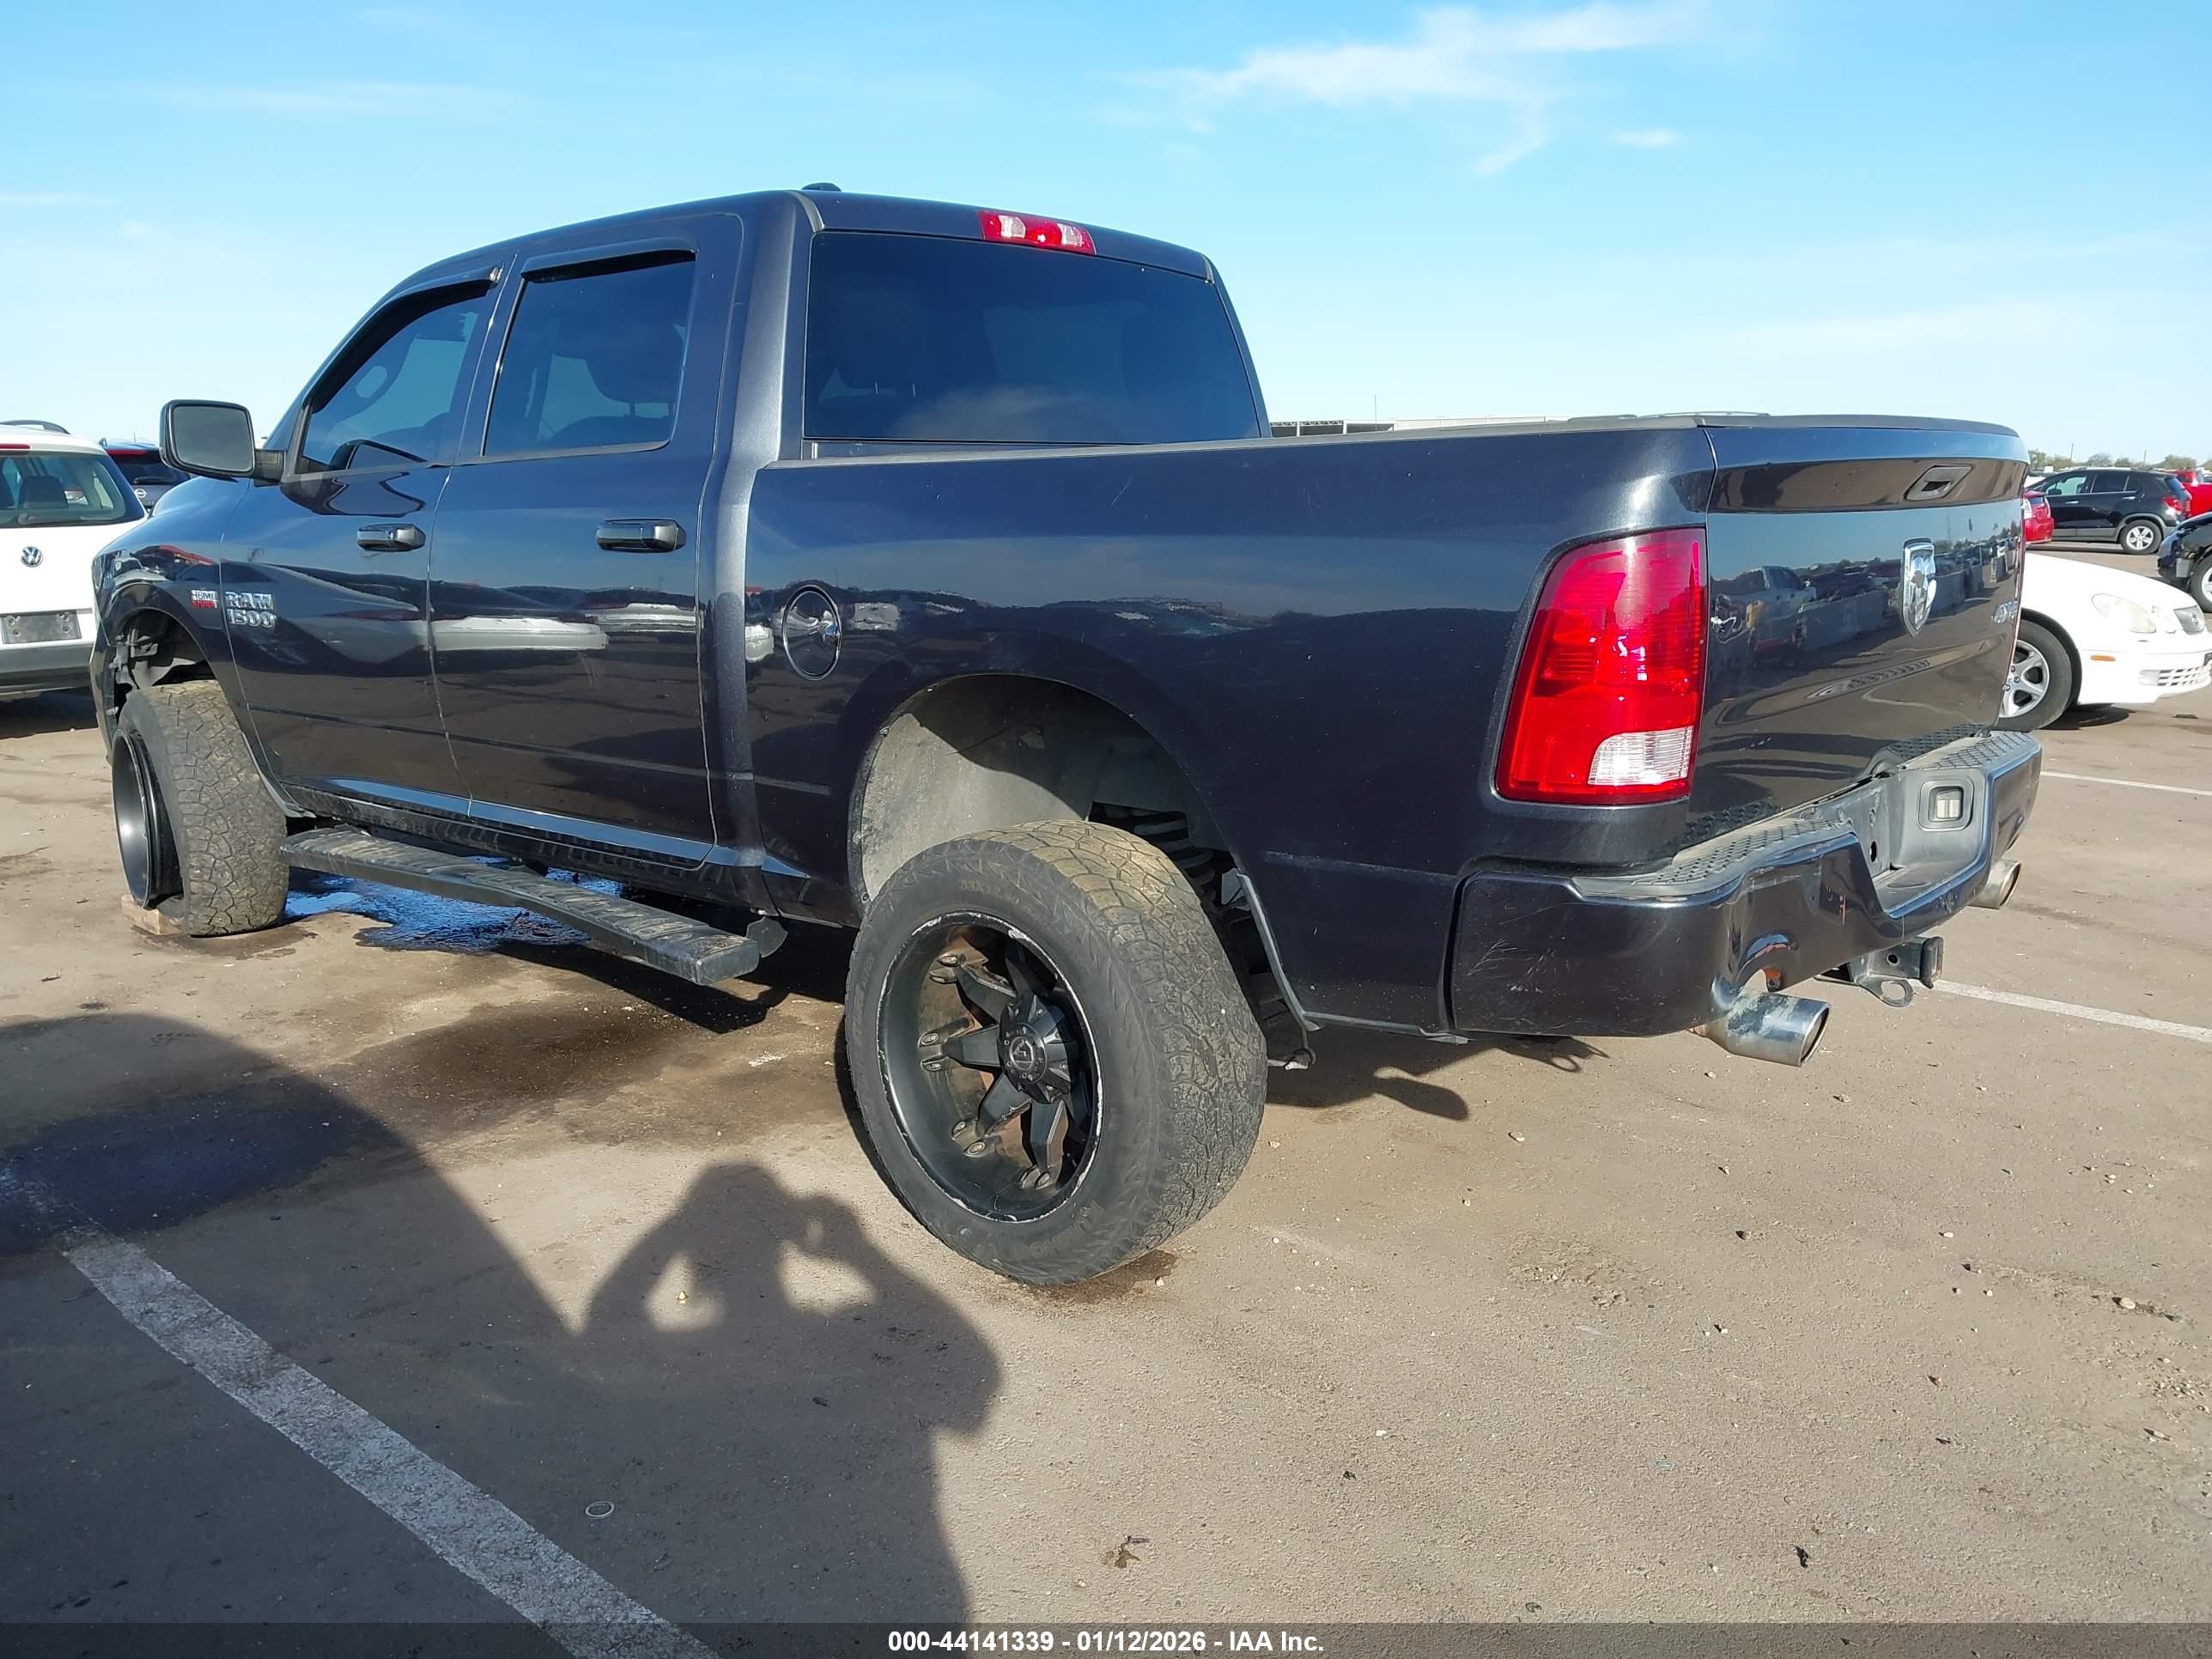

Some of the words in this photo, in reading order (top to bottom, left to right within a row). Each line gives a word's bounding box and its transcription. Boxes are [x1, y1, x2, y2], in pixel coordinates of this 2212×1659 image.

[191, 590, 218, 600] HEMI
[225, 591, 275, 610] RAM
[226, 608, 276, 628] 1500
